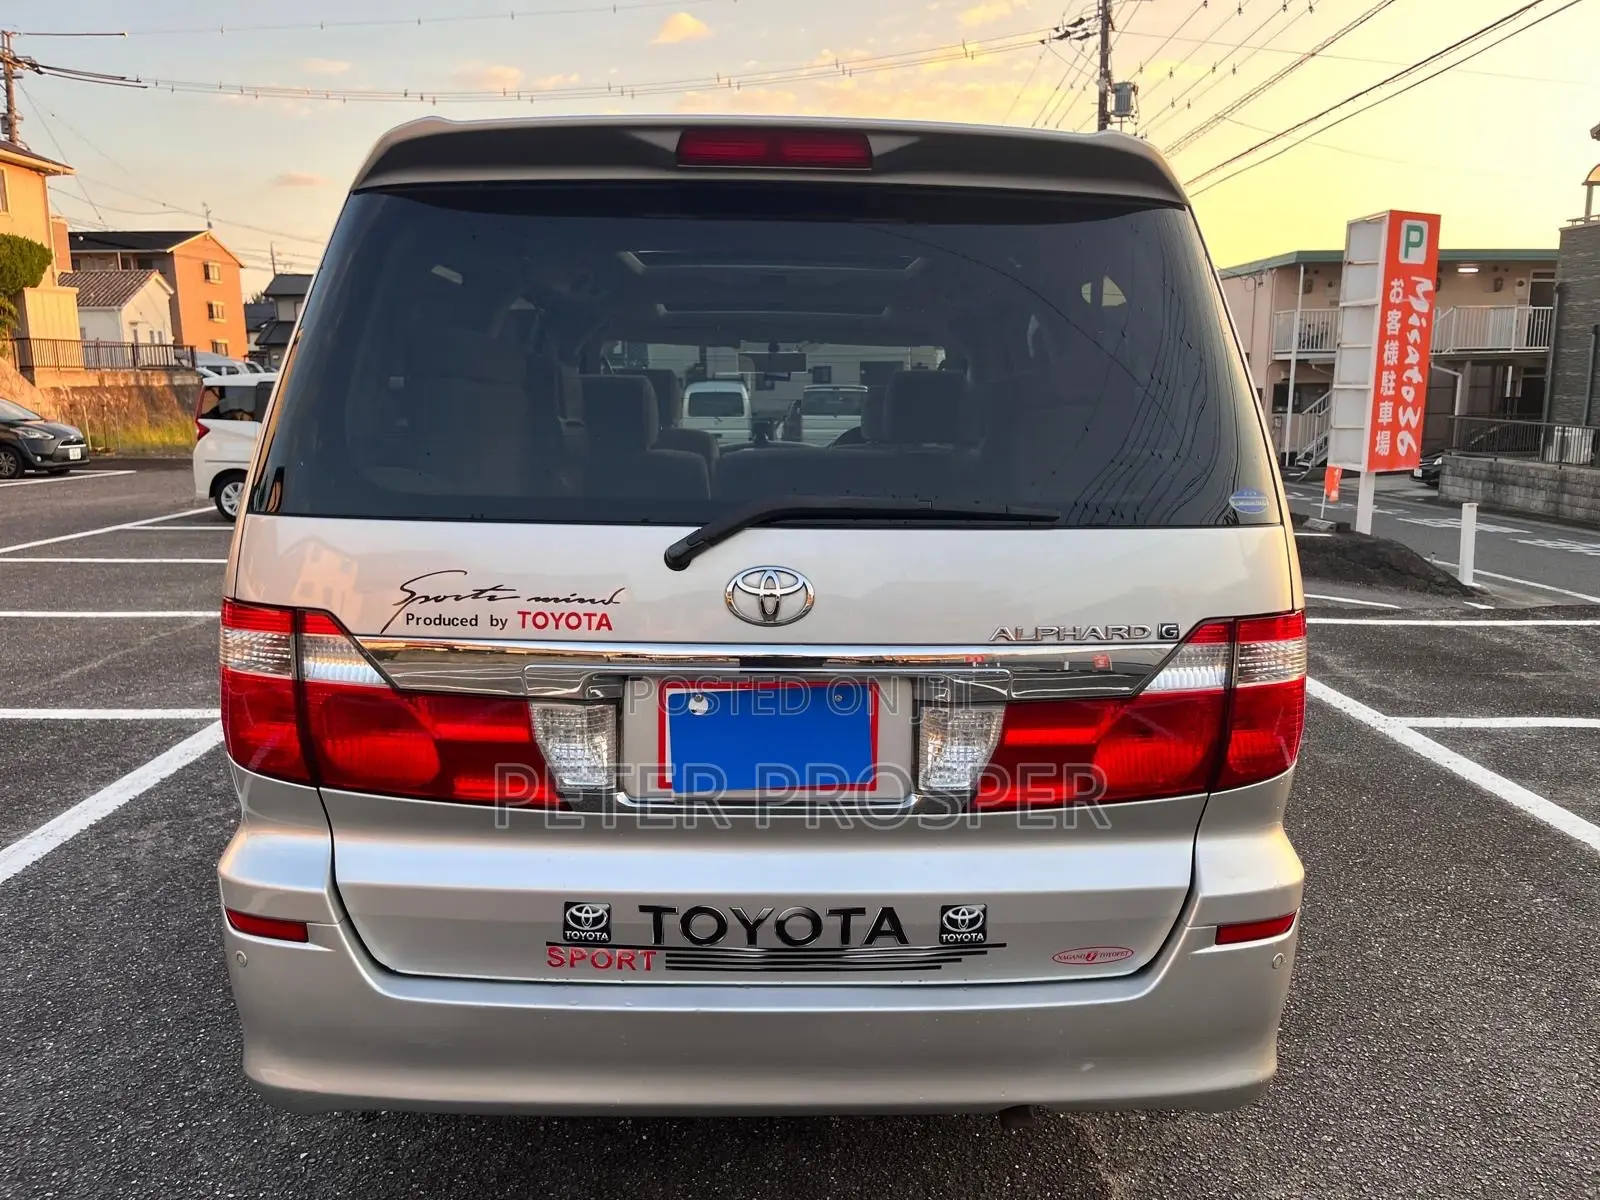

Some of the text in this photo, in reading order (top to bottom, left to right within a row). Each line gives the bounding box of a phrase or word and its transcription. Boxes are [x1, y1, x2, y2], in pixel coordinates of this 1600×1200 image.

[1404, 224, 1424, 259] P
[1375, 278, 1405, 456] お客様駐車場
[1396, 275, 1435, 457] Misato36
[406, 610, 613, 632] Produced by TOYOTA
[990, 623, 1179, 642] ALPHARD G
[565, 930, 609, 942] TOYOTA
[638, 904, 909, 947] TOYOTA
[941, 933, 985, 943] TOYOTA
[547, 946, 656, 971] SPORT
